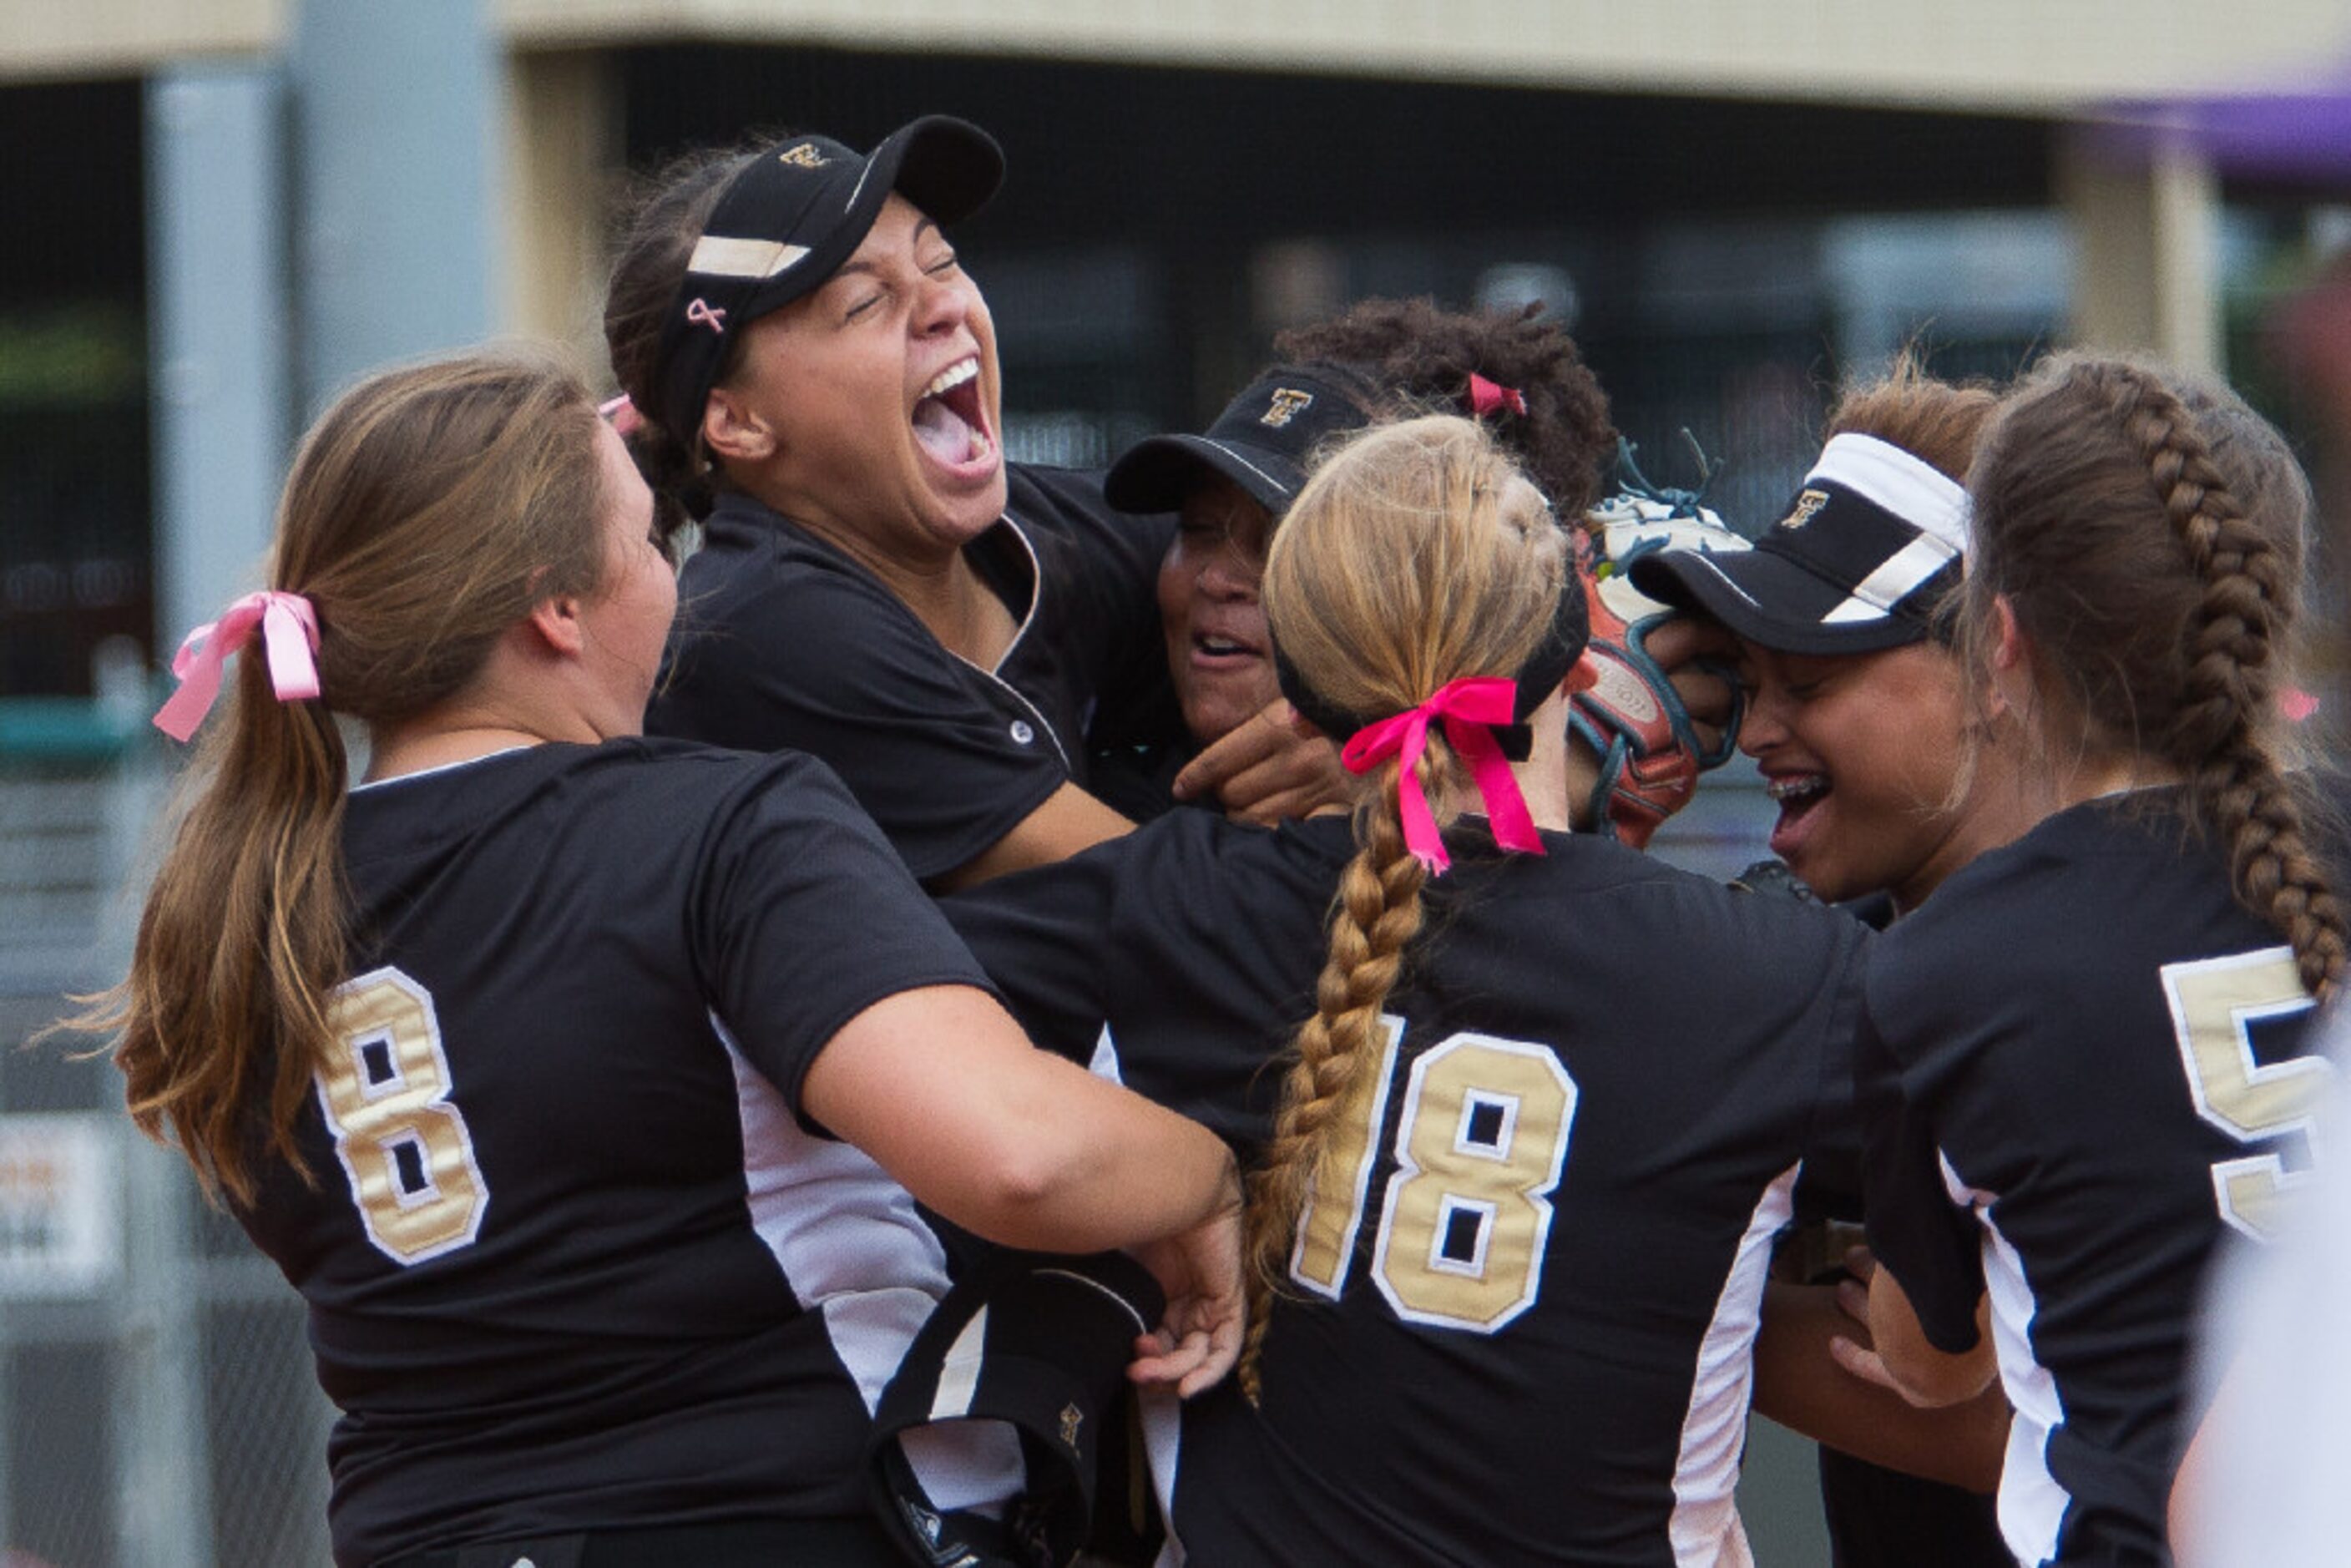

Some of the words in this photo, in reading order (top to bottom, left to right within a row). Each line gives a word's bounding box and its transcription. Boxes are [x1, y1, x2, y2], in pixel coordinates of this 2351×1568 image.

[315, 966, 489, 1267] 8
[1290, 1013, 1578, 1334] 18
[2160, 945, 2333, 1244] 5
